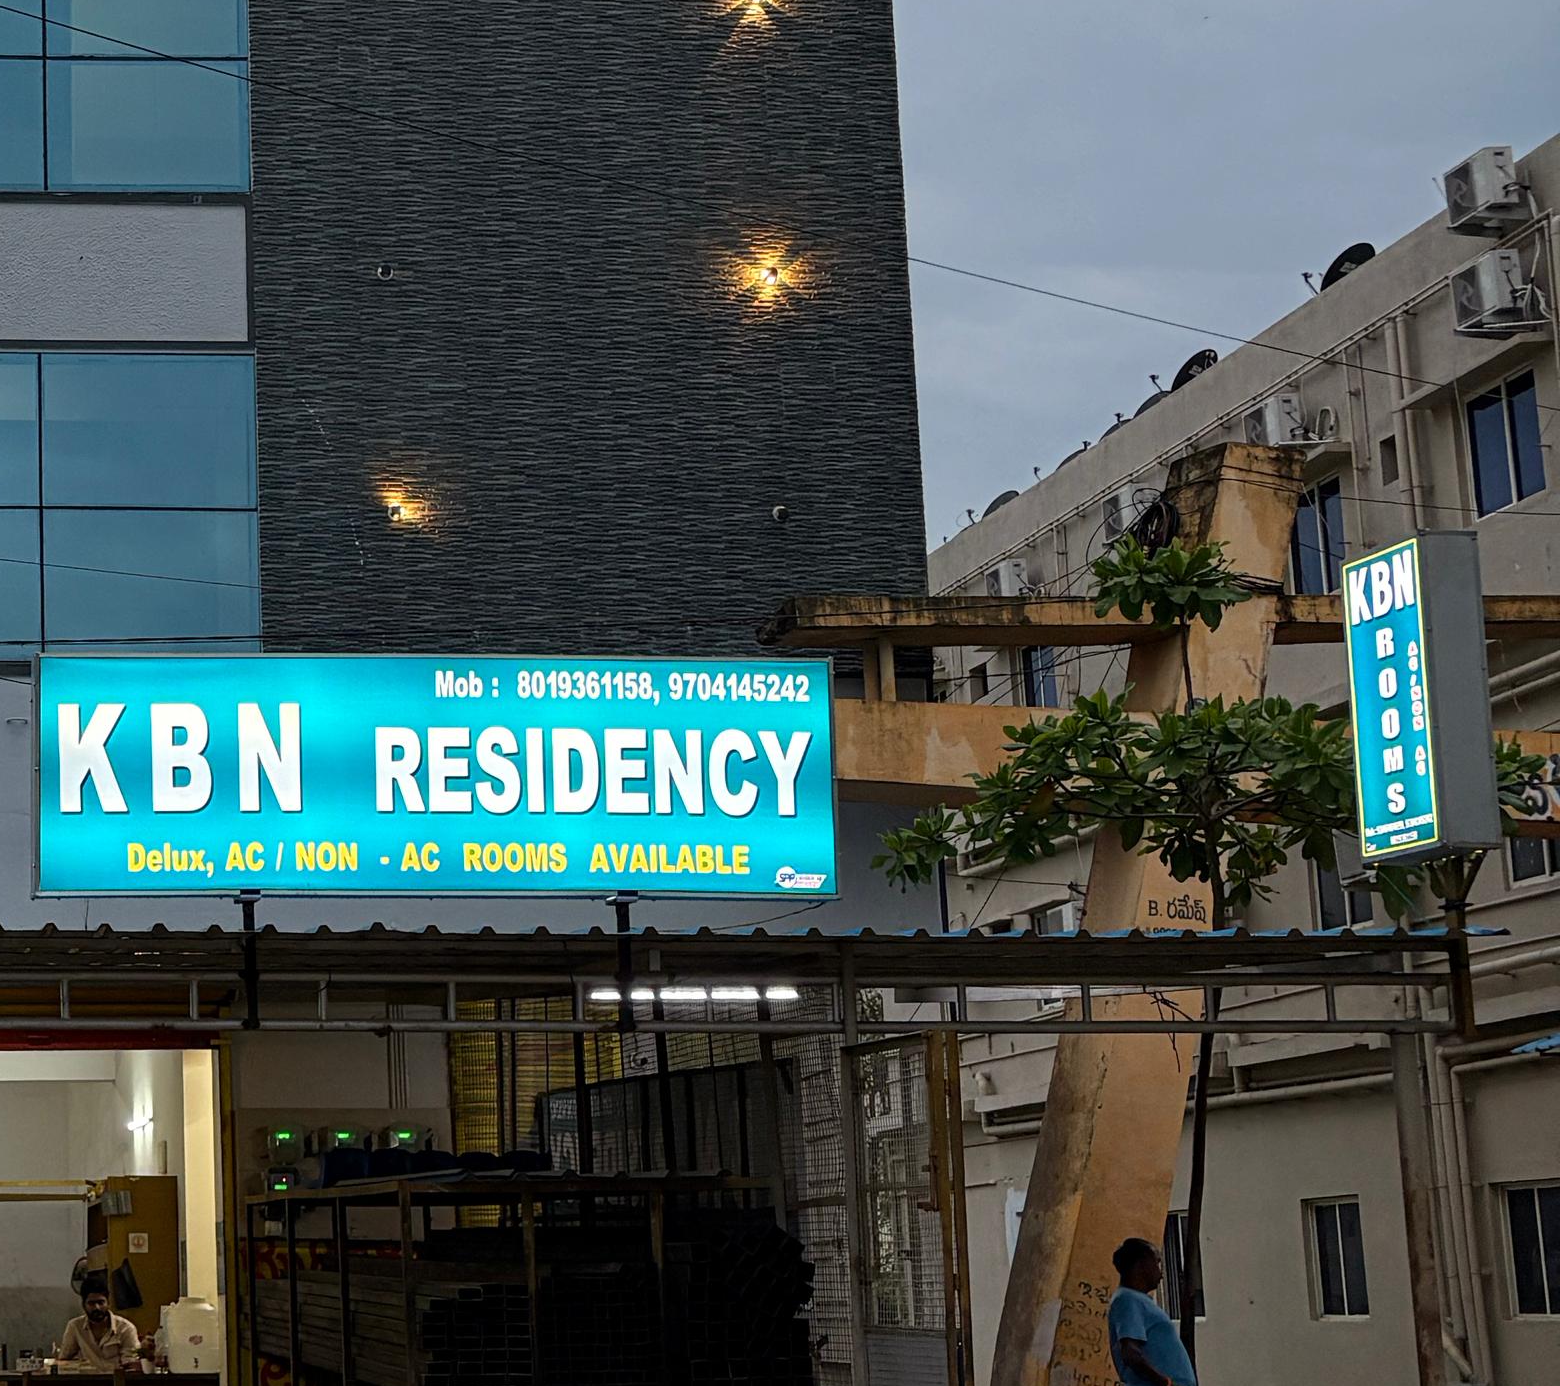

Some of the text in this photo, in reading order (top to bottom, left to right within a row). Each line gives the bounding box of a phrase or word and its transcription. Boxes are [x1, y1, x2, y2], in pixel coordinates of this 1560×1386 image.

[1348, 549, 1415, 626] KBN
[435, 670, 483, 698] Mob
[517, 670, 660, 705] 8019361158,
[668, 672, 810, 702] 9704145242
[375, 726, 811, 816] RESIDENCY
[127, 842, 214, 878] Delux,
[295, 841, 358, 872] NON
[401, 842, 440, 872] AC
[463, 842, 568, 873] ROOMS
[589, 843, 750, 874] AVAILABLE
